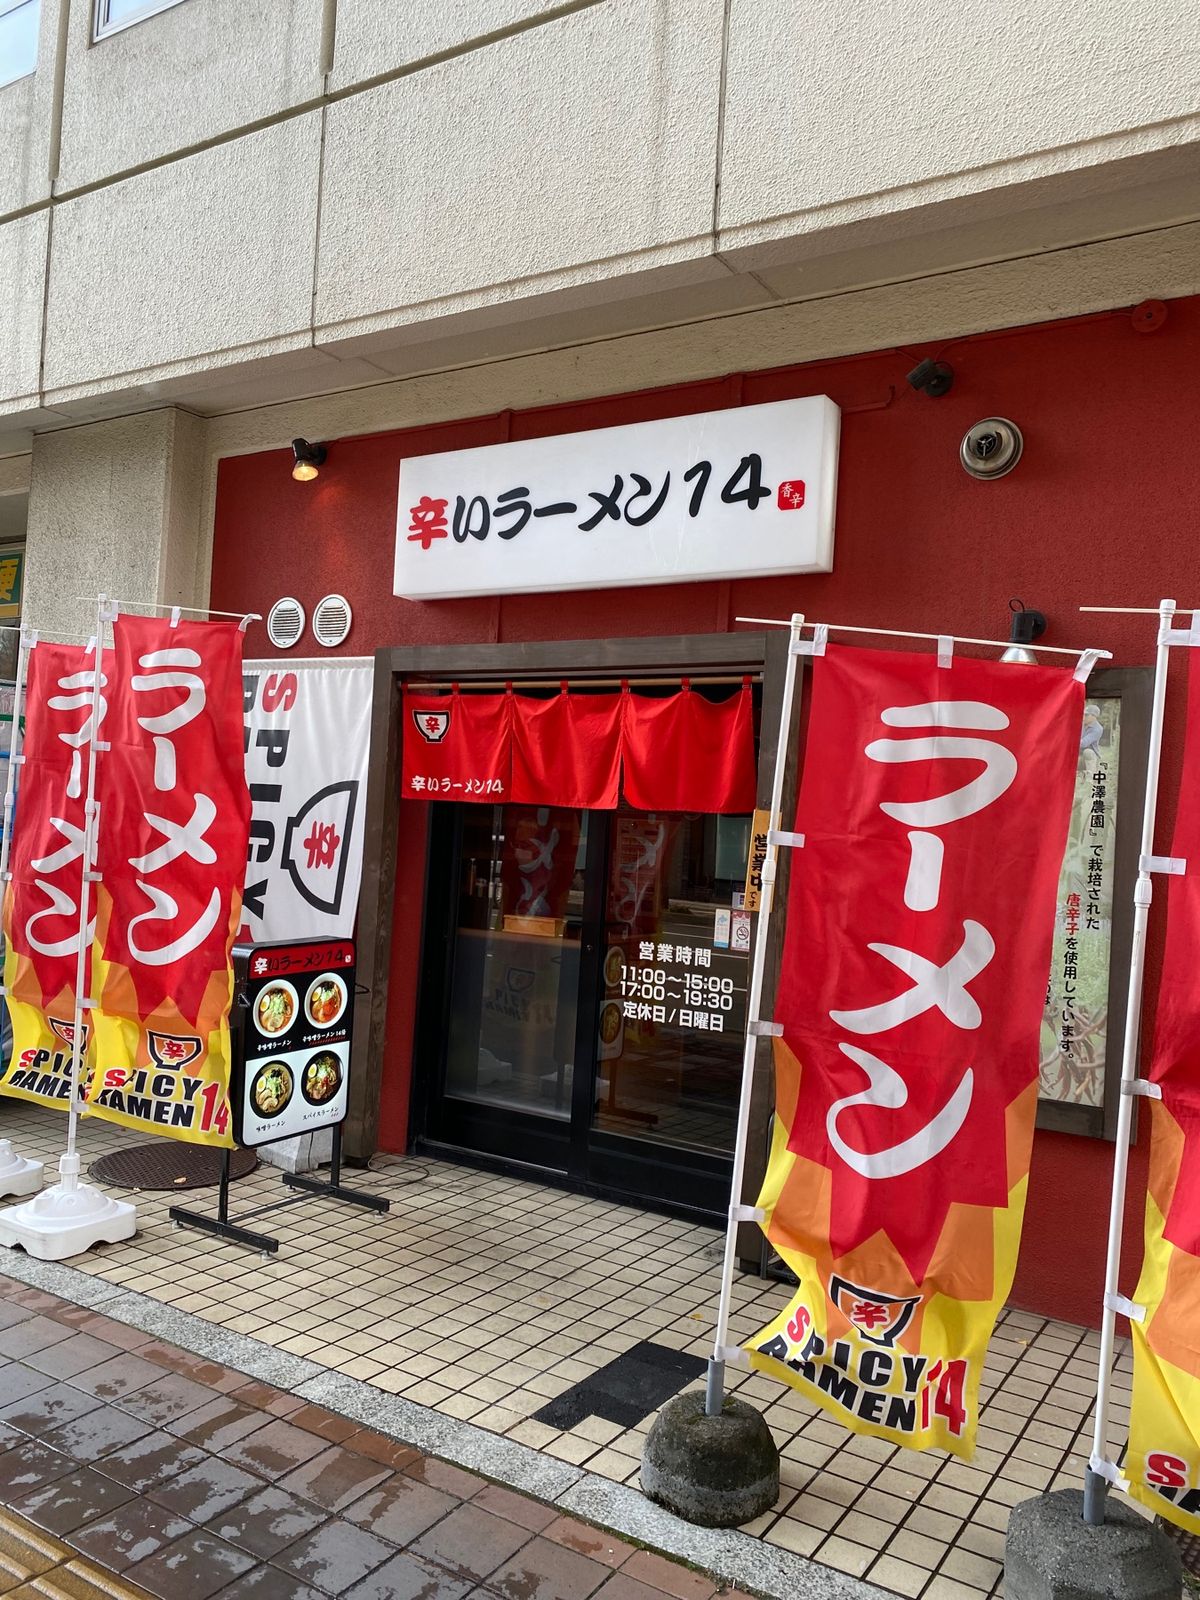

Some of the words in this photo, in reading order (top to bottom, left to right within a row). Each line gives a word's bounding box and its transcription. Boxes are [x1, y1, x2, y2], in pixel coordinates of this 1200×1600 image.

[407, 453, 772, 550] 辛いラーメン14
[780, 482, 803, 508] 香辛
[425, 715, 441, 733] 辛
[411, 775, 504, 794] 辛いラーメン14
[128, 648, 221, 966] ラーメン
[303, 820, 341, 869] 辛
[639, 941, 712, 968] 営業時間
[826, 700, 1019, 1180] ラーメン
[1060, 893, 1082, 1059] 唐辛子を使用しています。
[162, 1040, 185, 1060] 辛
[853, 1302, 890, 1329] 辛
[921, 1359, 968, 1436] 14
